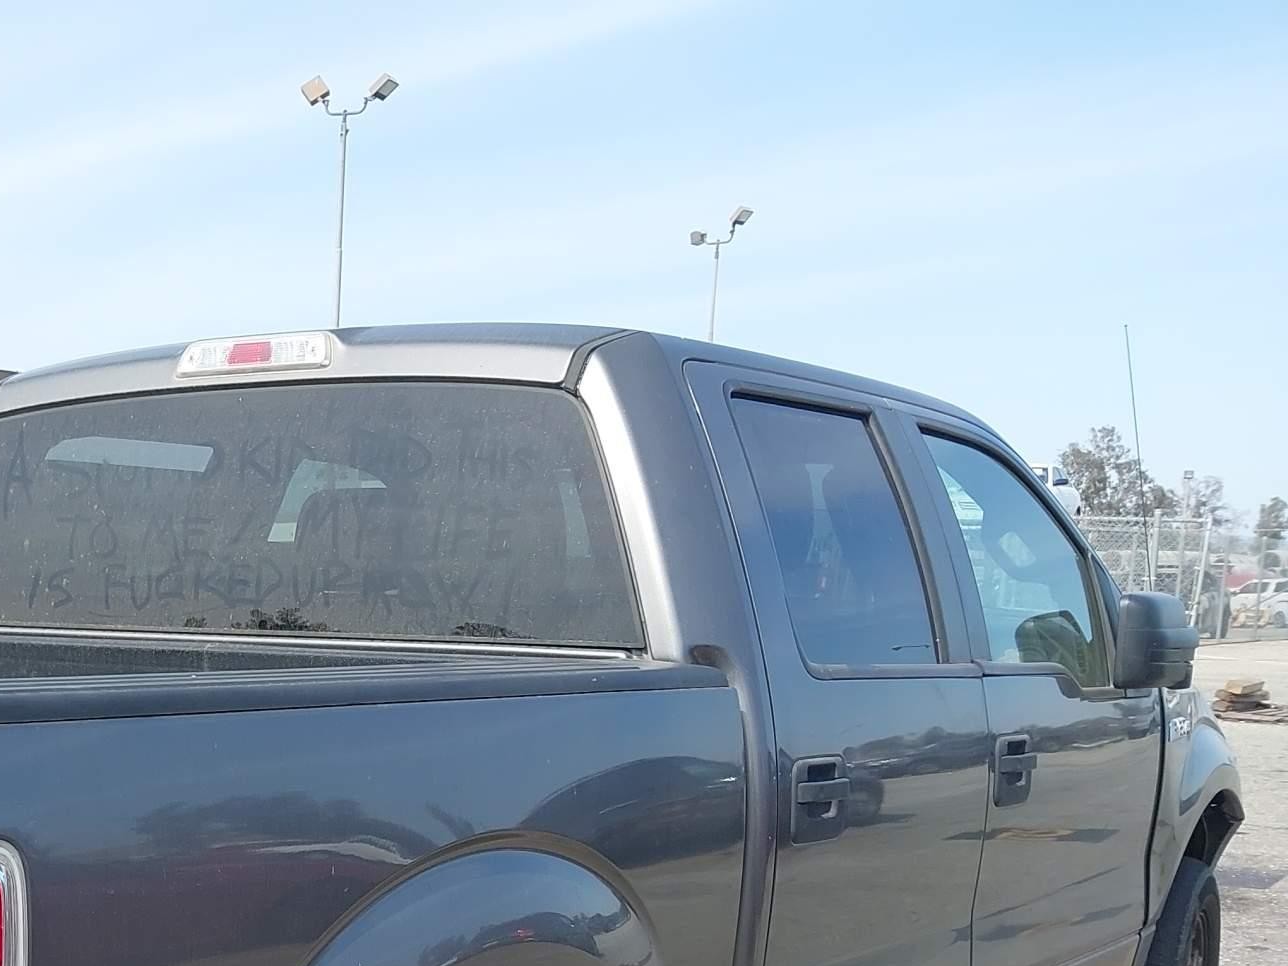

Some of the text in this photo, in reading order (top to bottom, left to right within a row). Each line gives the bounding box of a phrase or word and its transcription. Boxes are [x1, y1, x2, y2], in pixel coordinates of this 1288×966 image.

[1, 430, 32, 521] A
[46, 440, 226, 500] STUD
[56, 514, 118, 559] TO
[27, 566, 76, 609] IS
[101, 558, 283, 610] FUCKED
